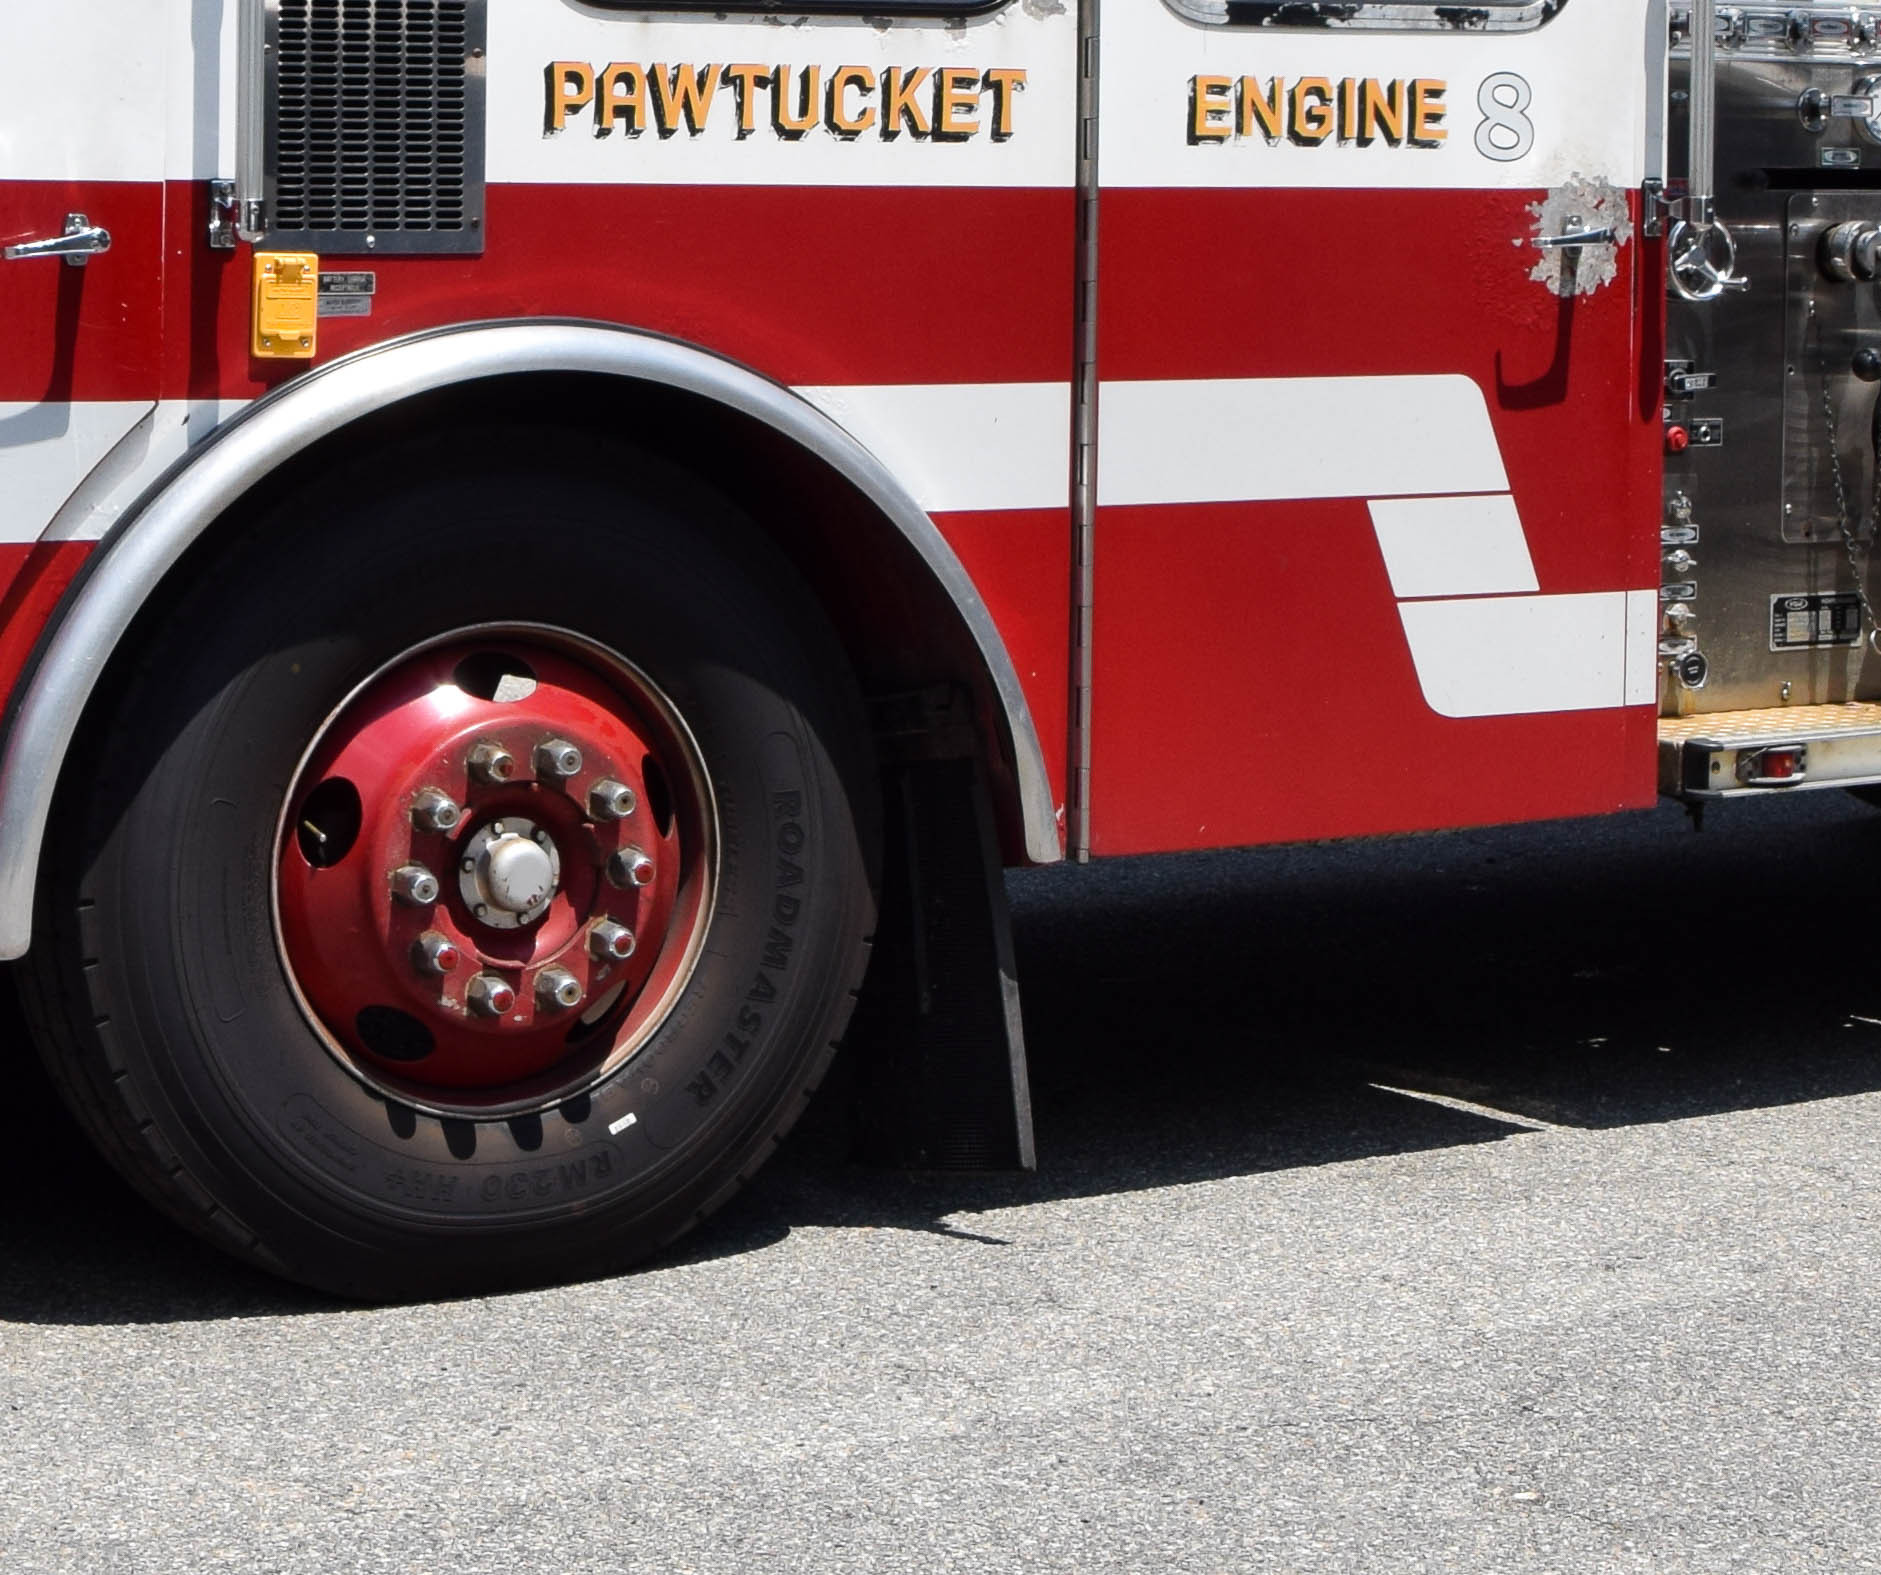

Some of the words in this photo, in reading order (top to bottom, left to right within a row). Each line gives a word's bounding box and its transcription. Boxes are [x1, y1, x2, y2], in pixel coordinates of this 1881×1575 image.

[542, 60, 1029, 143] PAWTUCKET
[1186, 73, 1449, 149] ENGINE
[1473, 70, 1535, 162] 8
[683, 788, 806, 1110] ROADMASTER
[479, 1151, 614, 1204] RM230
